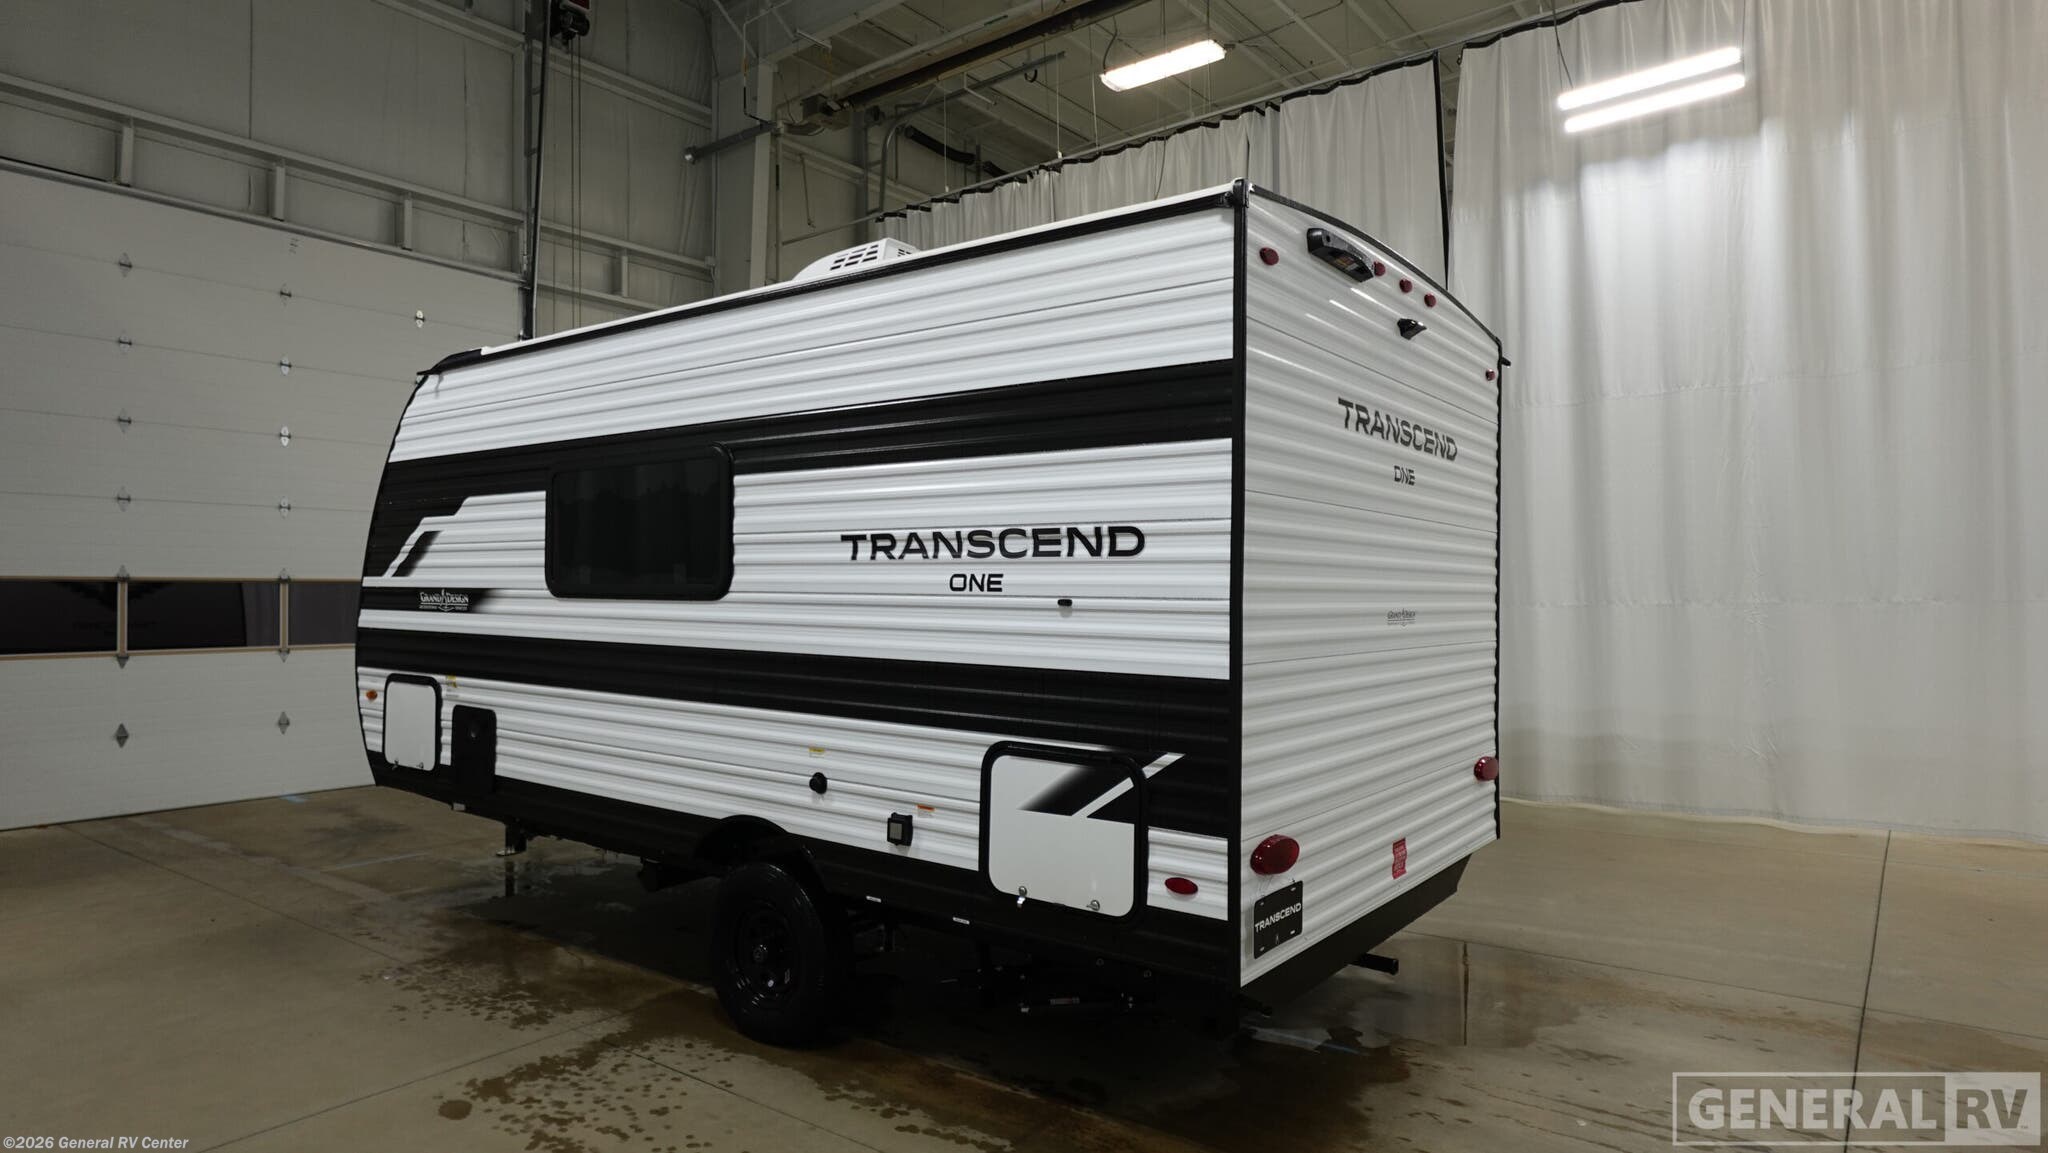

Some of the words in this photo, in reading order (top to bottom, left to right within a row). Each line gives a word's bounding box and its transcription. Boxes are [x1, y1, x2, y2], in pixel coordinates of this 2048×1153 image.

[1338, 397, 1458, 461] TRANSCEND
[1393, 465, 1416, 486] ONE
[841, 526, 1146, 561] TRANSCEND
[949, 573, 1004, 593] ONE
[1254, 902, 1302, 933] TRANSCEND
